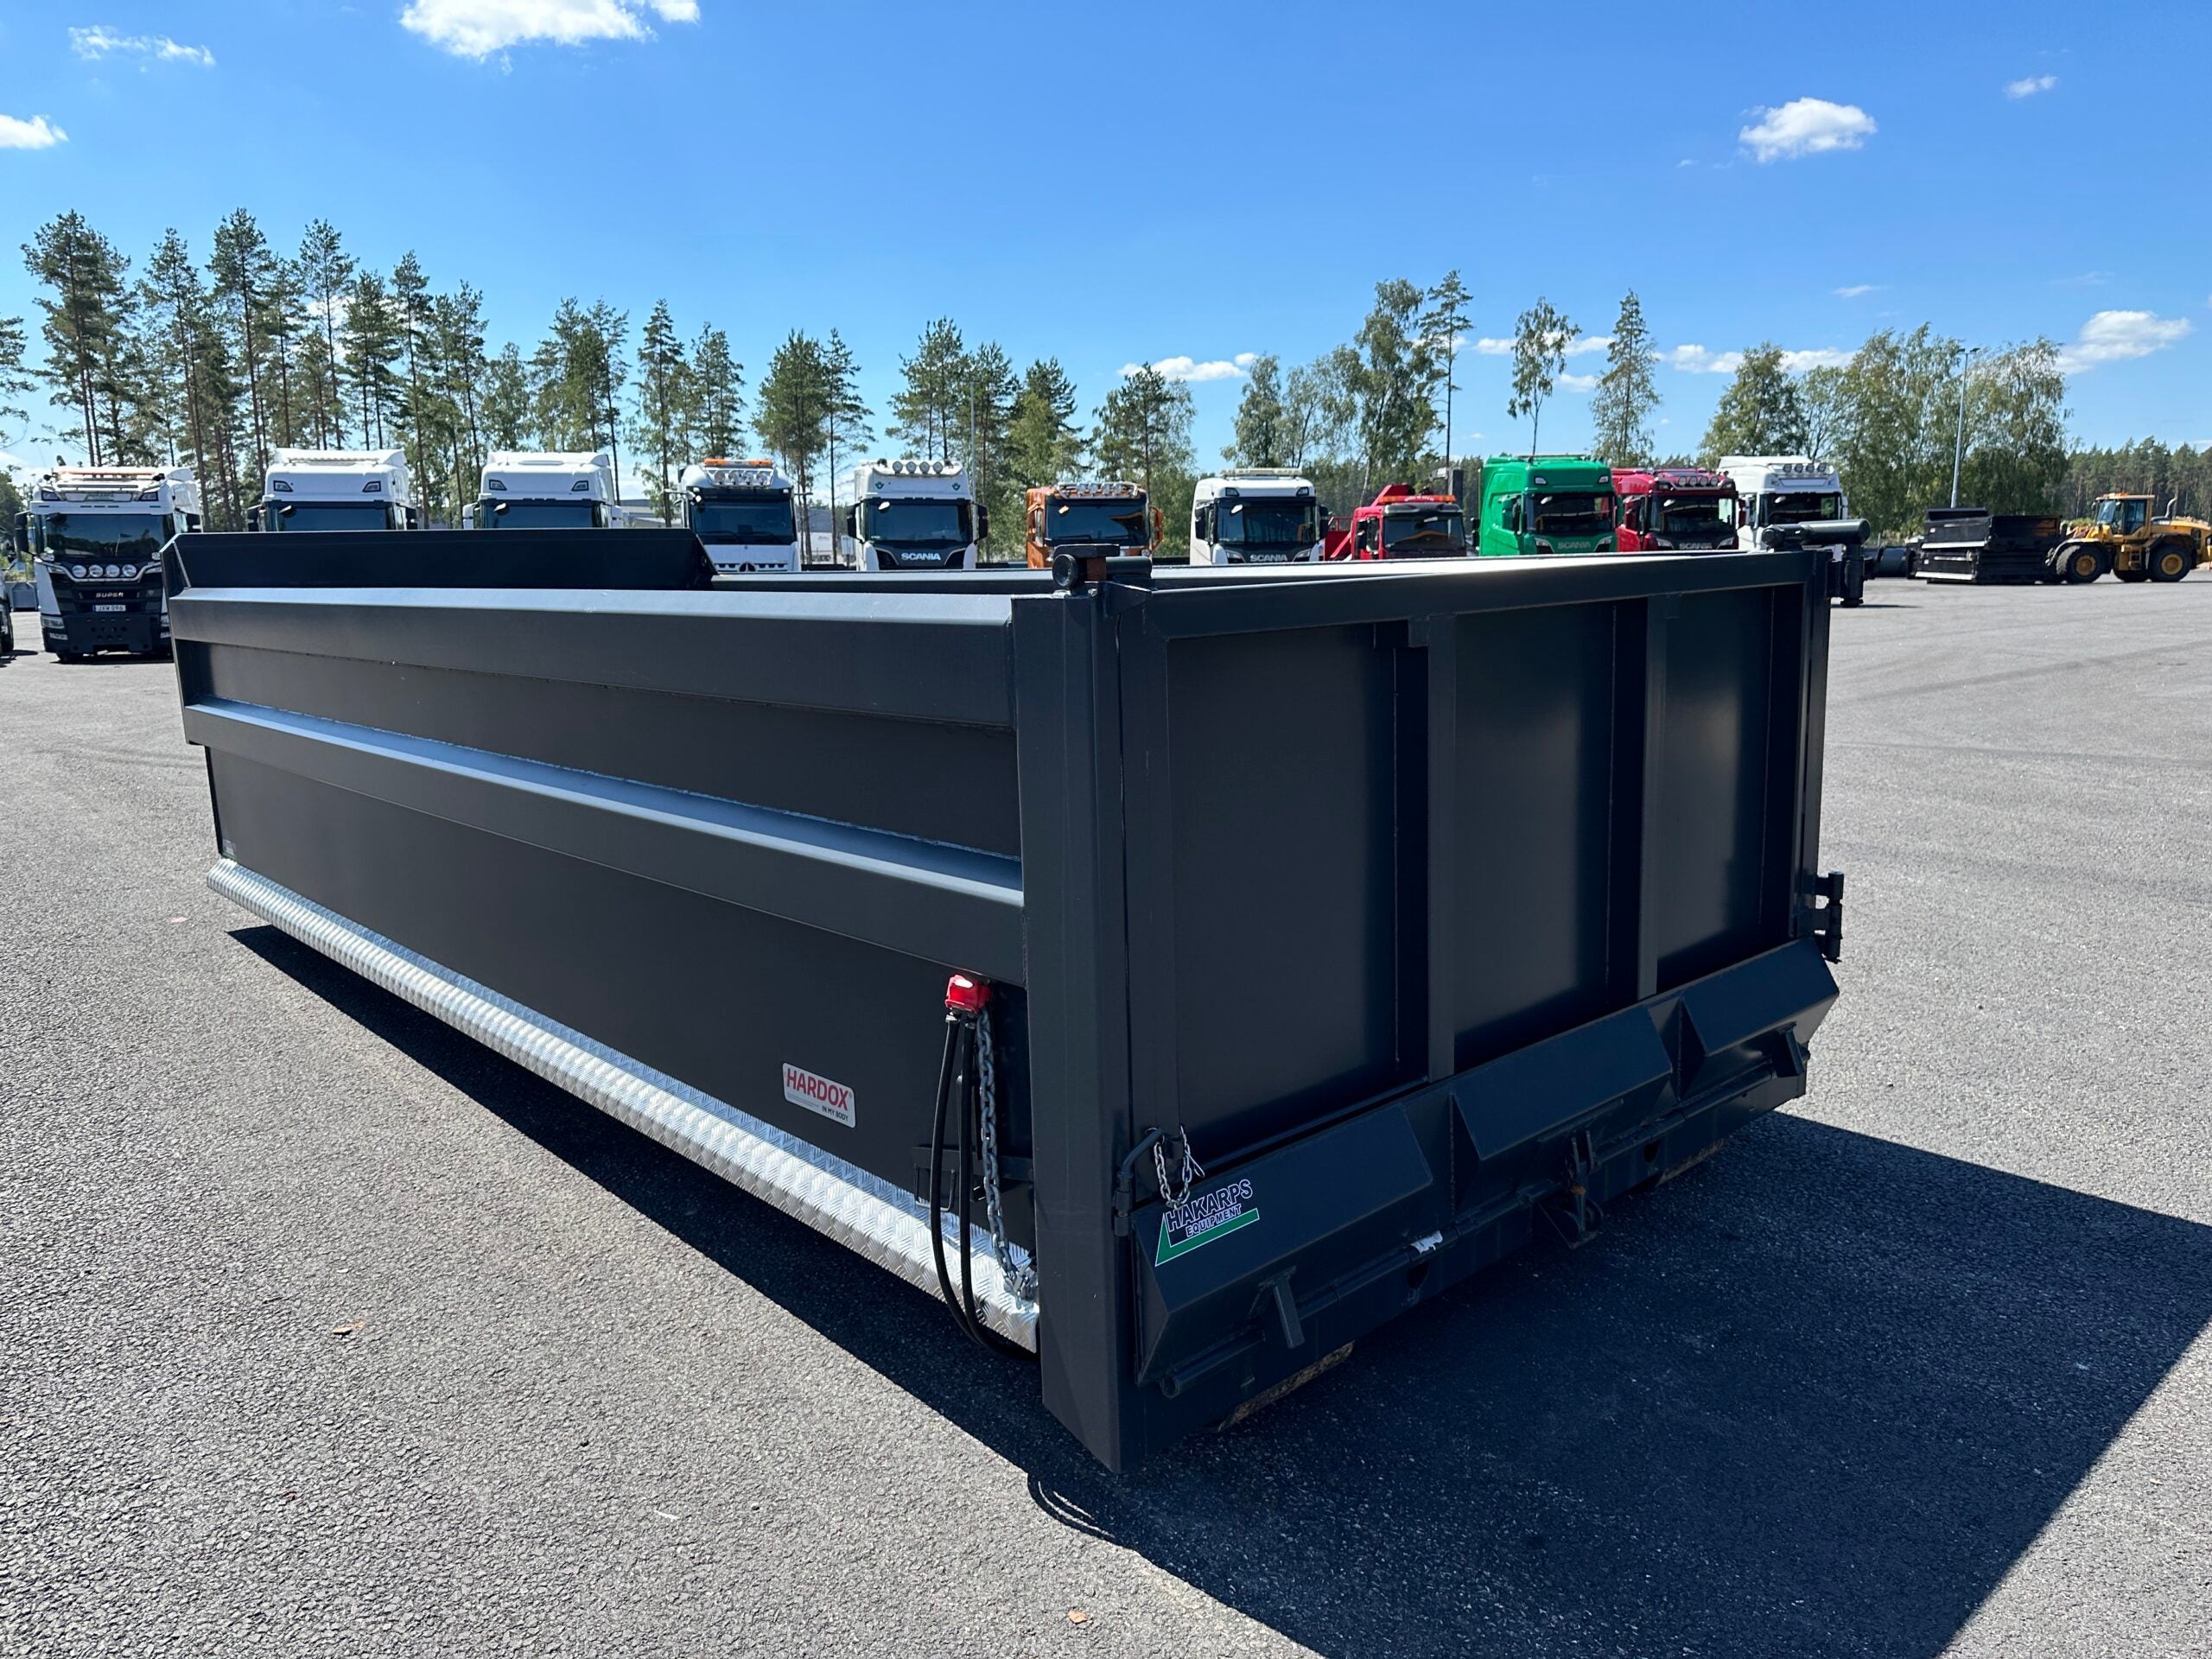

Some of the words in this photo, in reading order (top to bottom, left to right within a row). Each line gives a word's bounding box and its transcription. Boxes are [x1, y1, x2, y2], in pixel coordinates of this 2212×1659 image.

[901, 552, 941, 561] SCANIA
[787, 1067, 849, 1111] HARDOX
[836, 1110, 849, 1122] BODY
[1166, 1179, 1254, 1233] HAKARPS
[1185, 1204, 1243, 1238] EQUIPMENT
